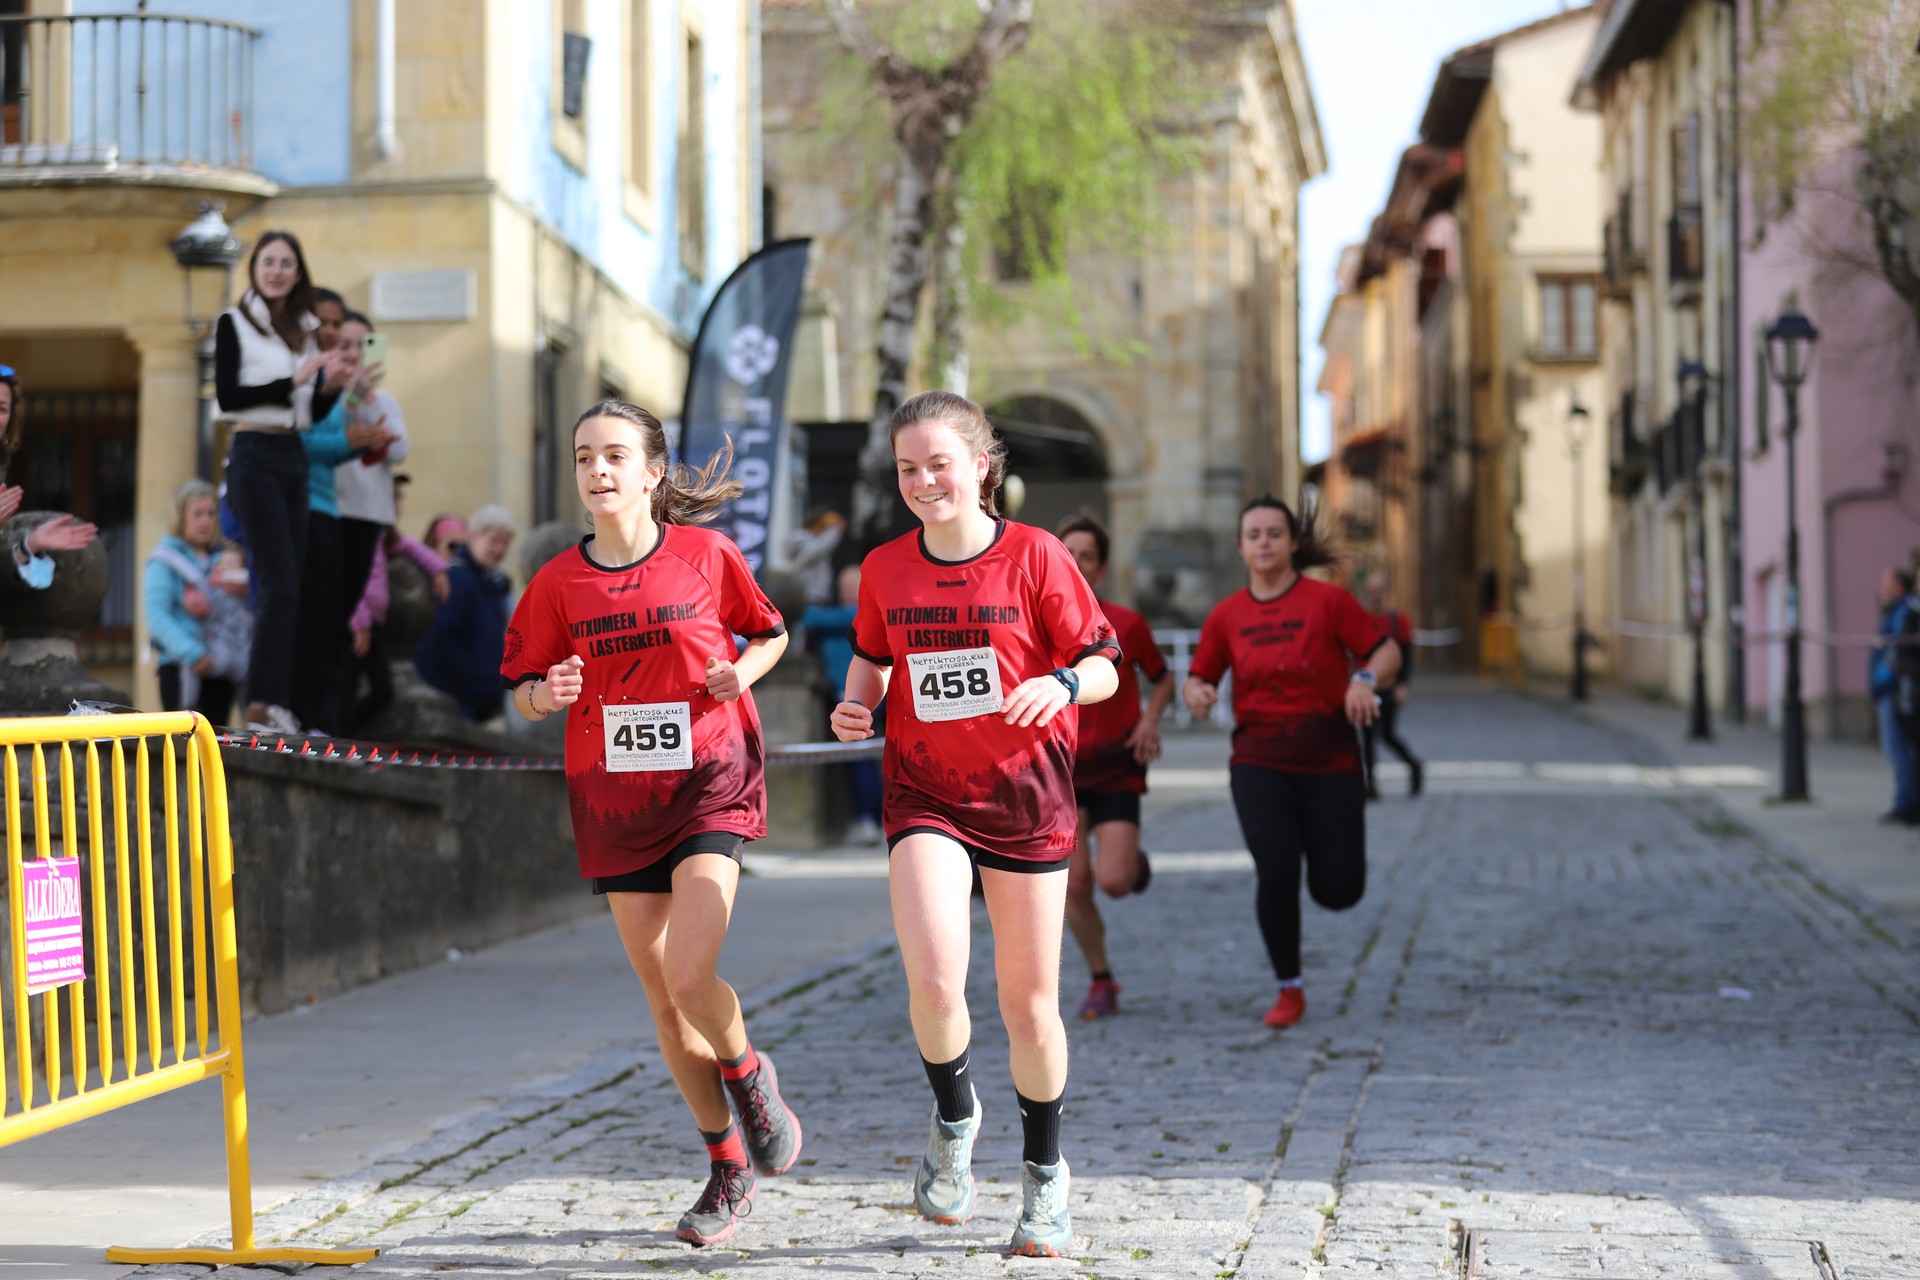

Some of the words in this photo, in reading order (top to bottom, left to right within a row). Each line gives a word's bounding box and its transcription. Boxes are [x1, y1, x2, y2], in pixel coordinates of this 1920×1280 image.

[734, 398, 771, 573] FLOTA
[589, 627, 673, 658] LASTERKETA
[907, 629, 991, 648] LASTERKETA
[911, 653, 990, 666] herrikrosa.eus
[919, 668, 991, 700] 458
[608, 708, 684, 717] herrikrosa.eus
[613, 722, 681, 751] 459
